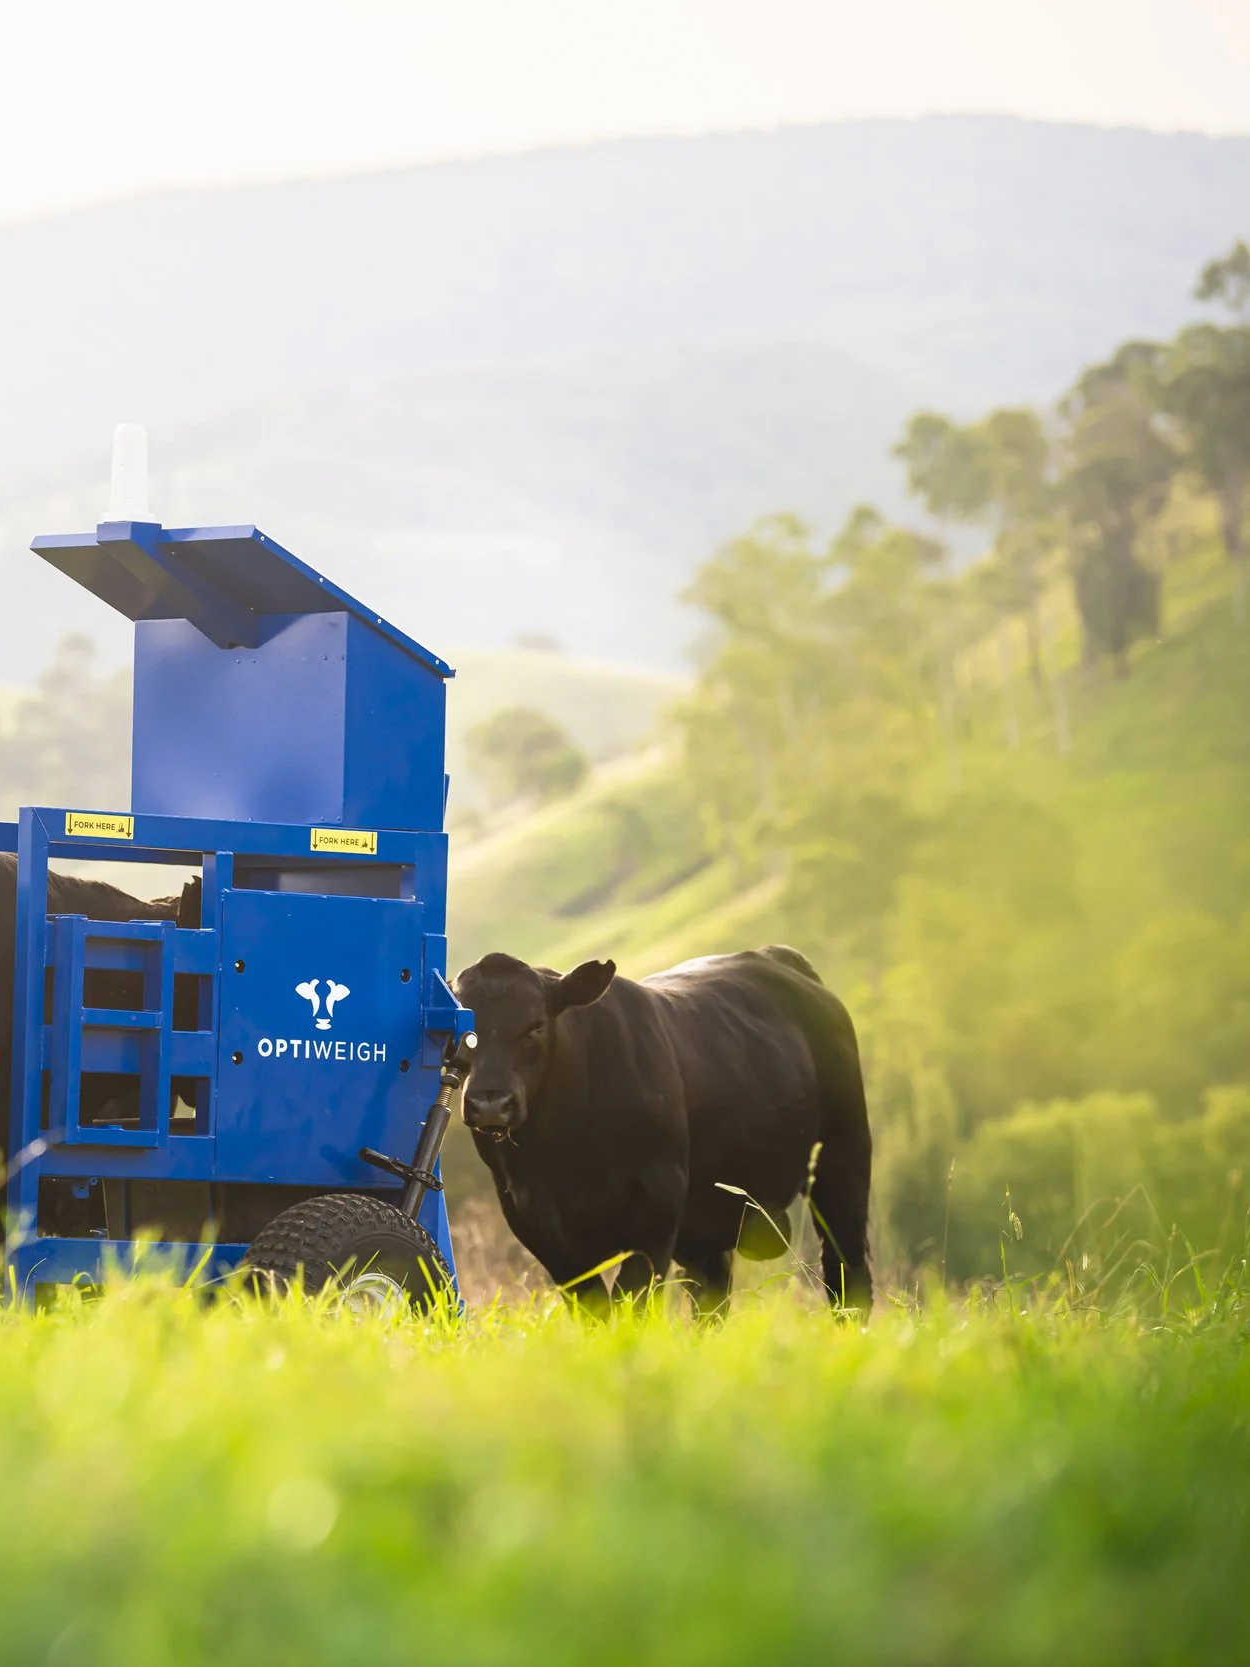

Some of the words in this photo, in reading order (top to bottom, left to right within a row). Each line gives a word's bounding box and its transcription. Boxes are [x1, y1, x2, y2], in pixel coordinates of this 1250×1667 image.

[74, 821, 94, 829] FORK
[96, 822, 115, 830] HERE
[319, 836, 339, 845] FORK
[341, 838, 359, 846] HERE
[257, 1038, 386, 1062] OPTIWEIGH
